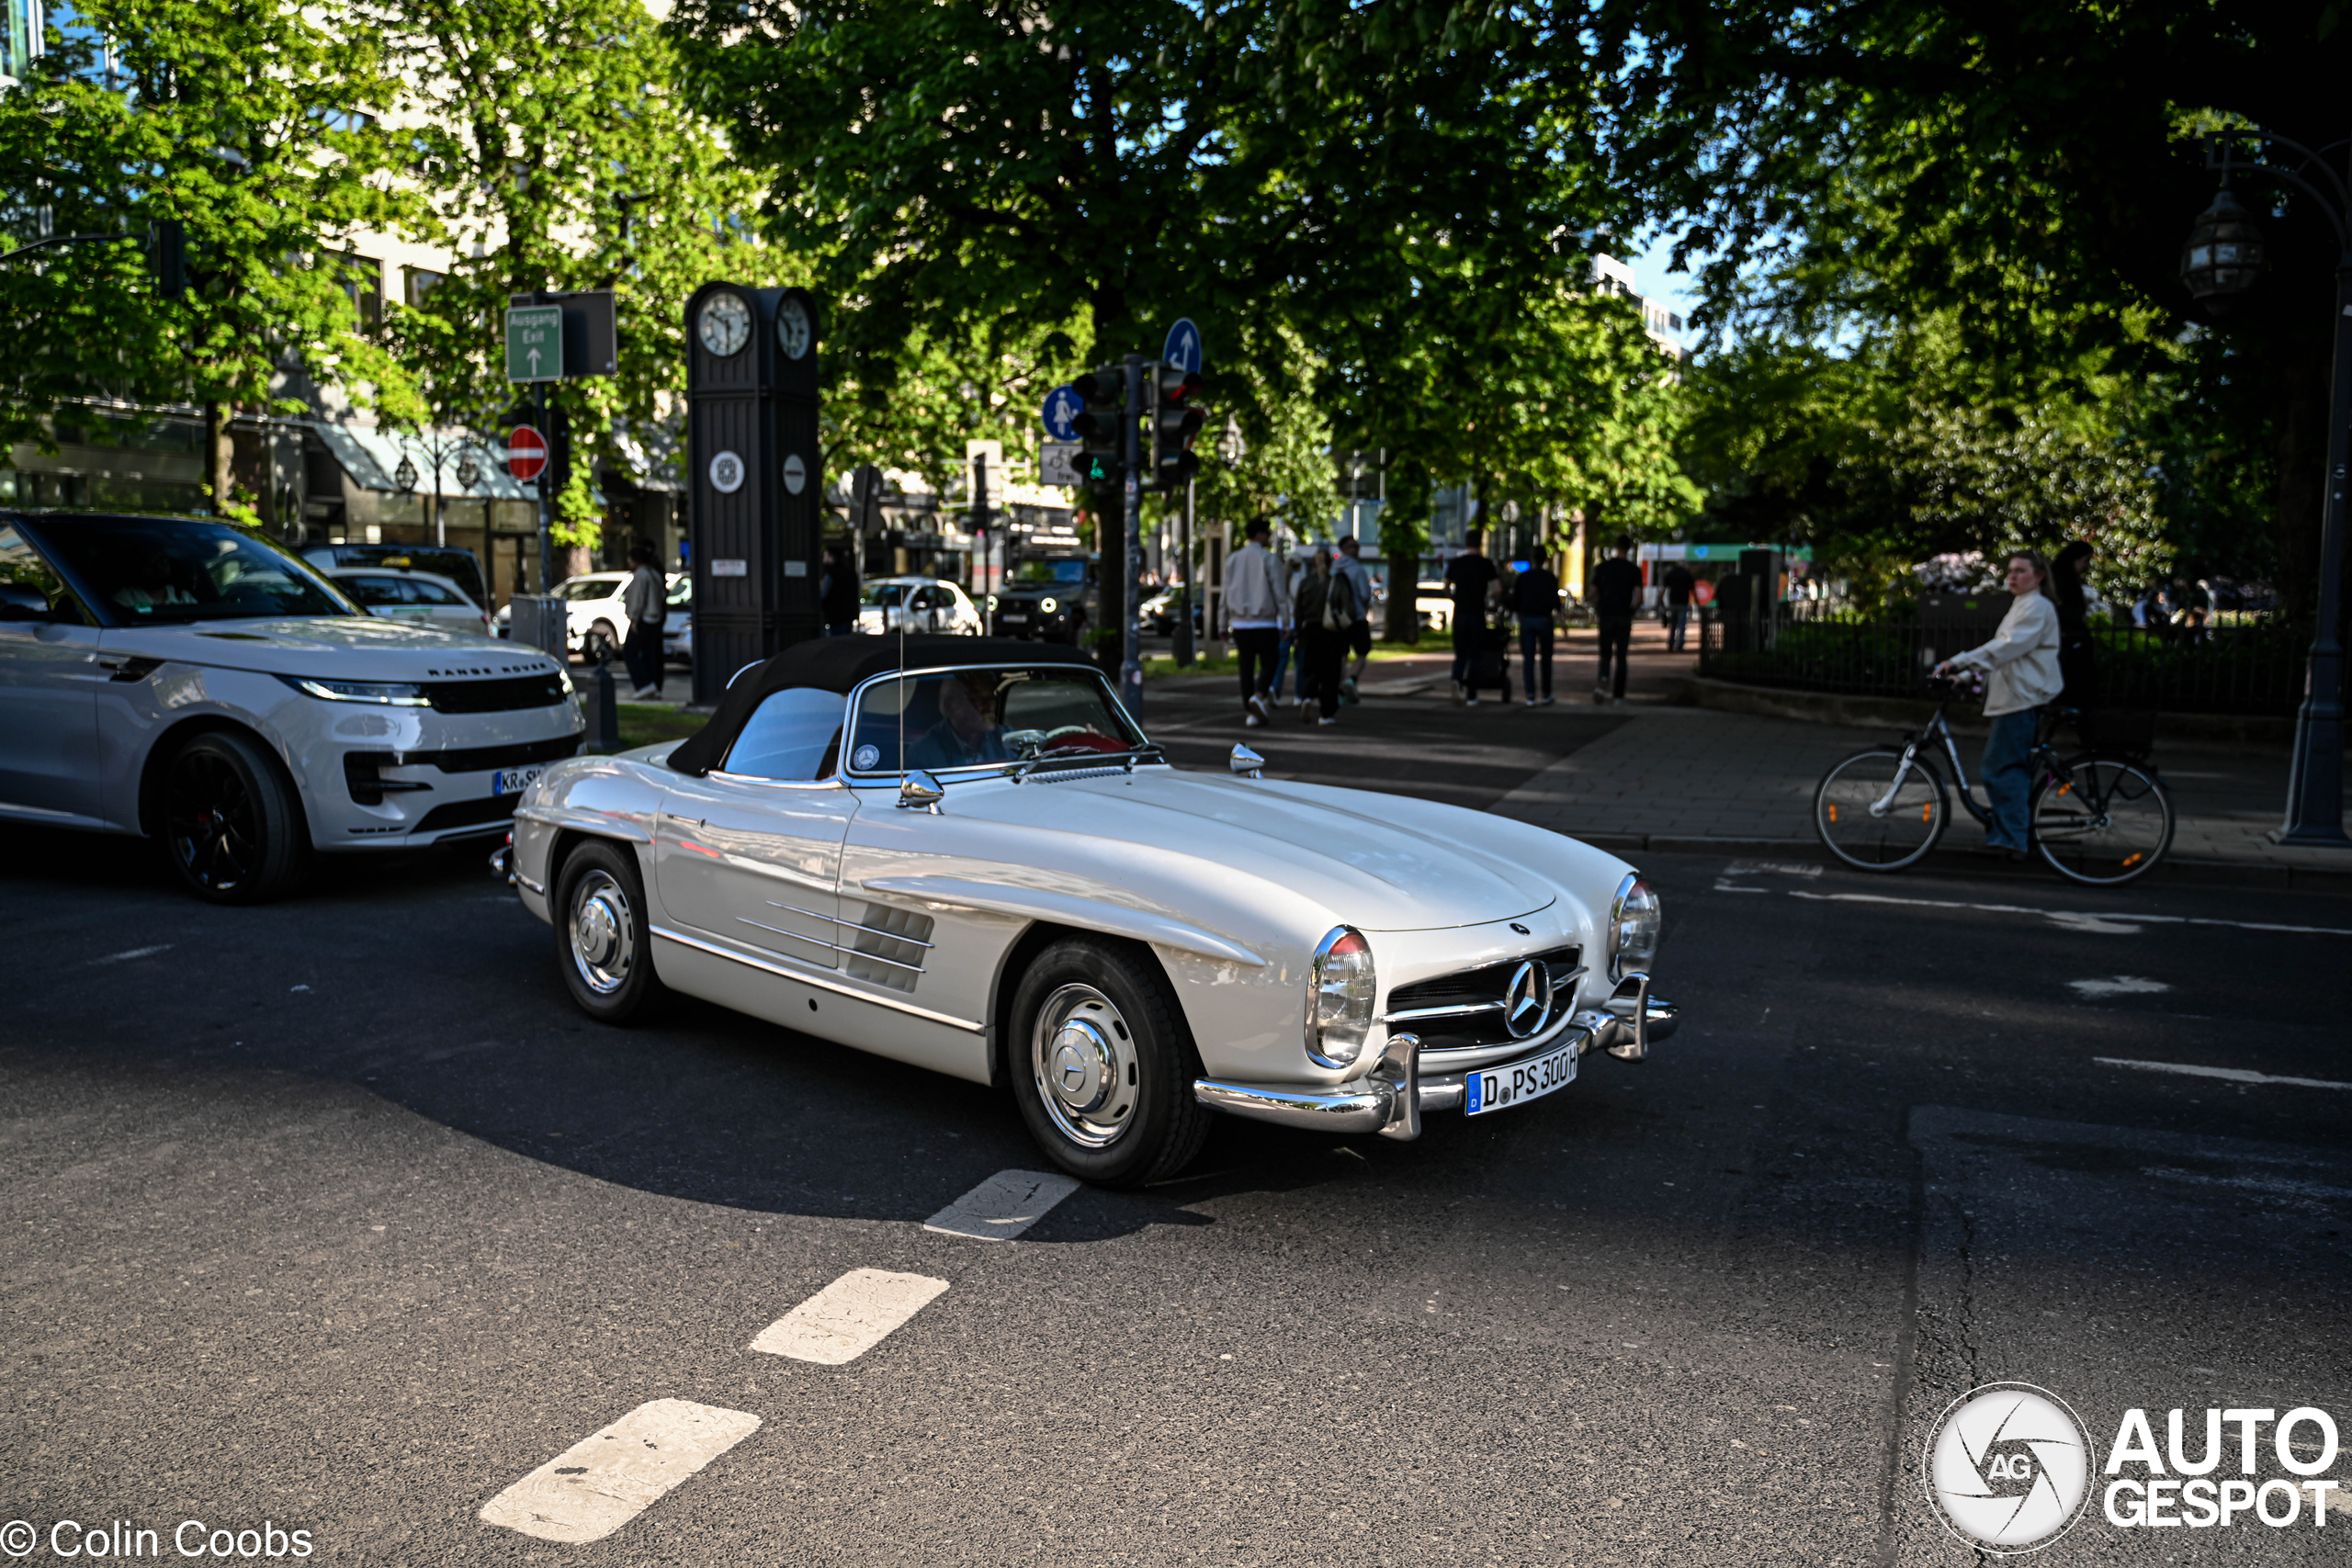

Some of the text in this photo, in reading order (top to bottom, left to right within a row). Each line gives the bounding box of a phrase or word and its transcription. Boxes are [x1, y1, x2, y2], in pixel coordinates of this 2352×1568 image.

[510, 312, 559, 329] Ausgang
[522, 329, 545, 344] Exit
[427, 661, 547, 677] RANGE ROVER
[502, 772, 518, 791] KR
[1483, 1075, 1498, 1107] D
[1541, 1045, 1577, 1089] 300H
